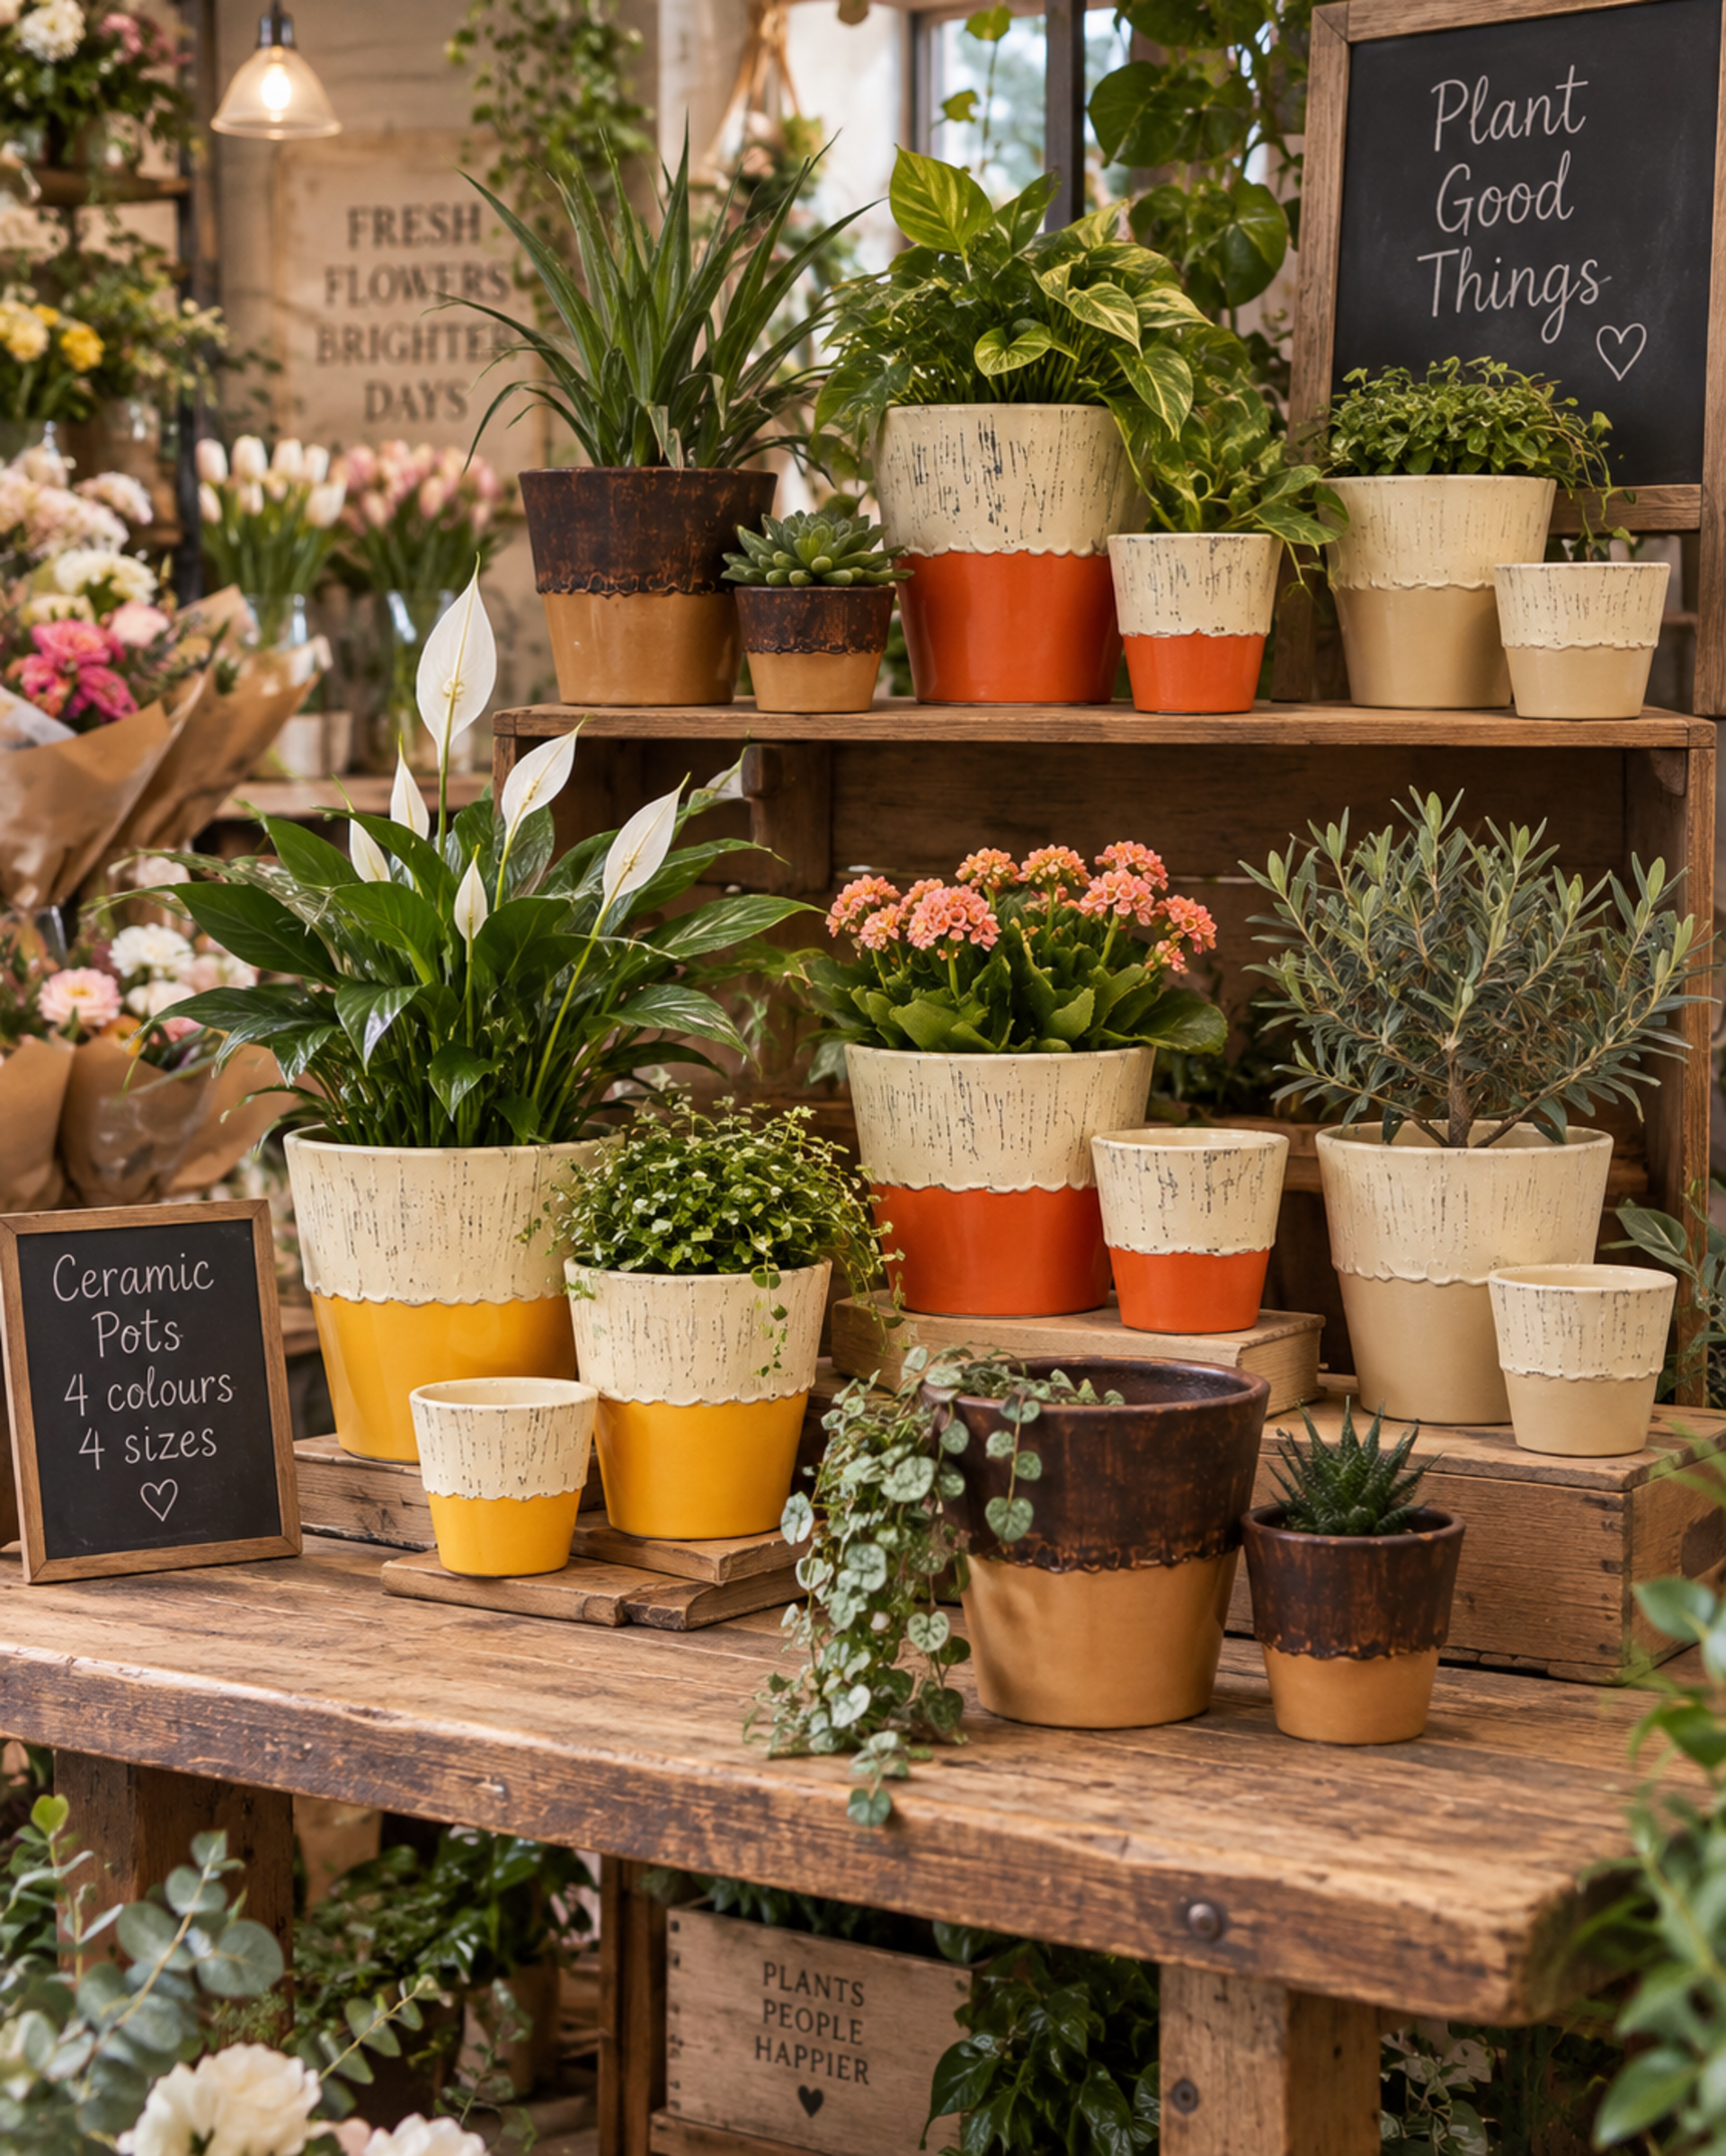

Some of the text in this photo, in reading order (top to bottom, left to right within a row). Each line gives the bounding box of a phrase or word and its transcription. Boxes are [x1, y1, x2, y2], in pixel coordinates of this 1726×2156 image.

[1430, 65, 1588, 152] Plant
[1436, 150, 1575, 236] Good
[348, 203, 481, 250] FRESH
[325, 262, 510, 307] FLOWERS
[1417, 245, 1613, 344] Things
[364, 379, 468, 423] DAYS
[52, 1253, 215, 1302] Ceramic
[91, 1309, 183, 1358] Pots
[64, 1365, 236, 1416] 4 colours
[78, 1425, 218, 1470] 4 sizes
[763, 1961, 865, 2007] PLANTS
[763, 1999, 864, 2046] PEOPLE
[754, 2035, 870, 2086] HAPPIER
